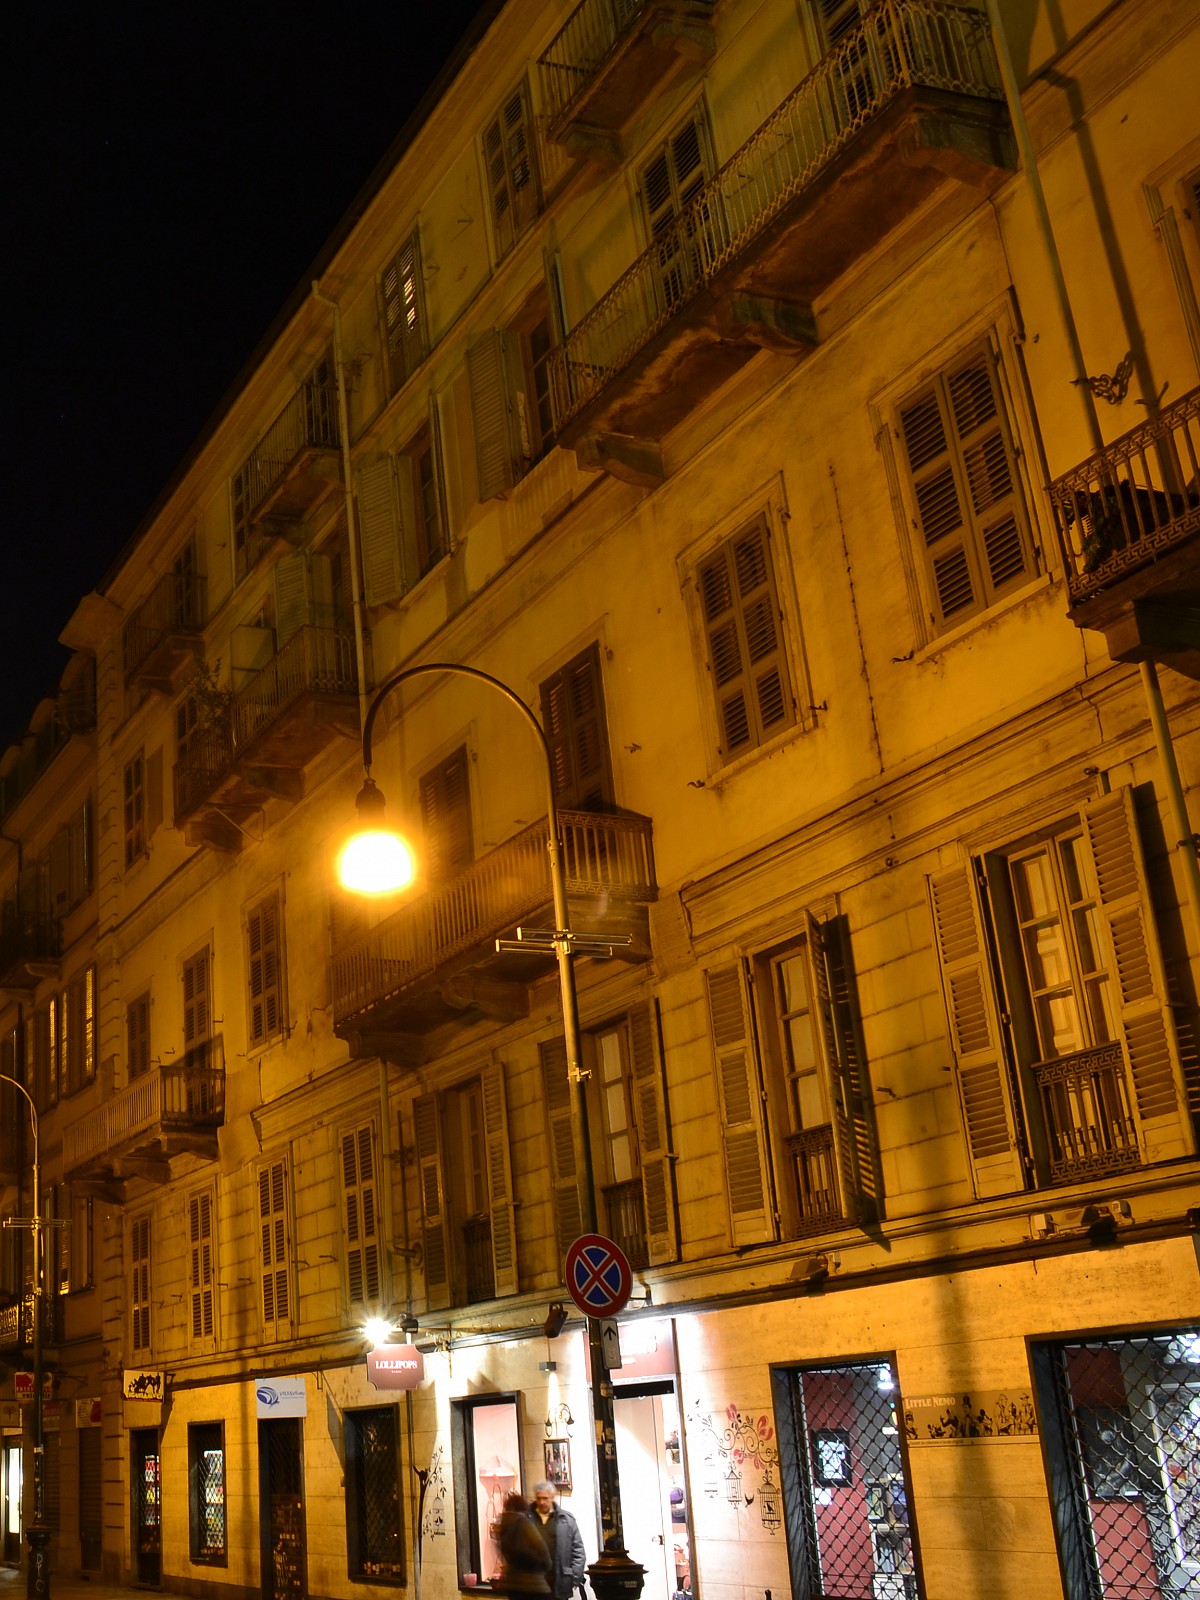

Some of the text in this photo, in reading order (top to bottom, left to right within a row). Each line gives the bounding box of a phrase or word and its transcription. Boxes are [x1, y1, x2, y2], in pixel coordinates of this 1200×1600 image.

[375, 1360, 417, 1369] LOLLIPOPS
[905, 1396, 955, 1409] LITTLE NEMO
